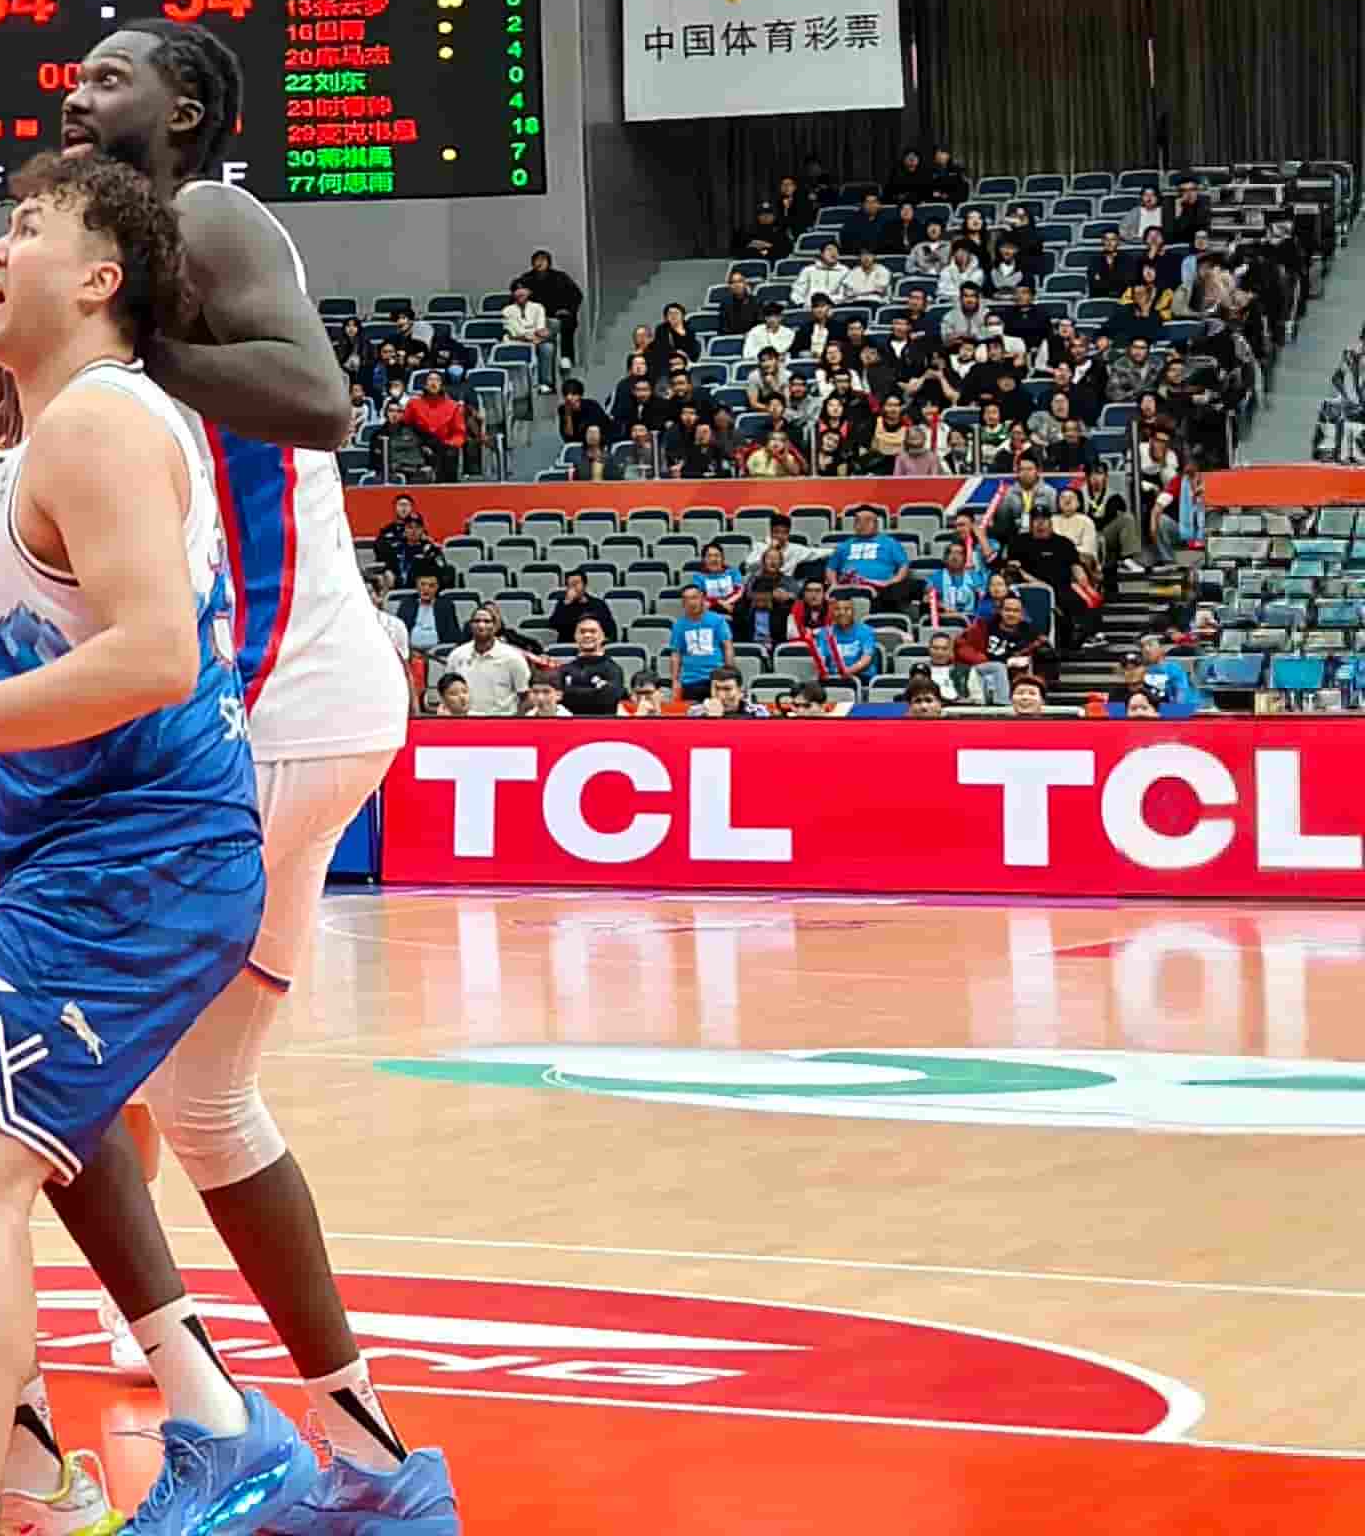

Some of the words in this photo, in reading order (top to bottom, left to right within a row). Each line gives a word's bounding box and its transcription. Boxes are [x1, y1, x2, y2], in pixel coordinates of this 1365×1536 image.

[506, 14, 524, 33] 2
[643, 12, 881, 63] 中国体育彩票
[284, 73, 314, 93] 22
[508, 65, 525, 83] 0
[509, 142, 526, 161] 7
[287, 175, 316, 194] 77
[511, 167, 528, 186] 0
[413, 740, 794, 863] TCL
[956, 742, 1364, 872] TCL
